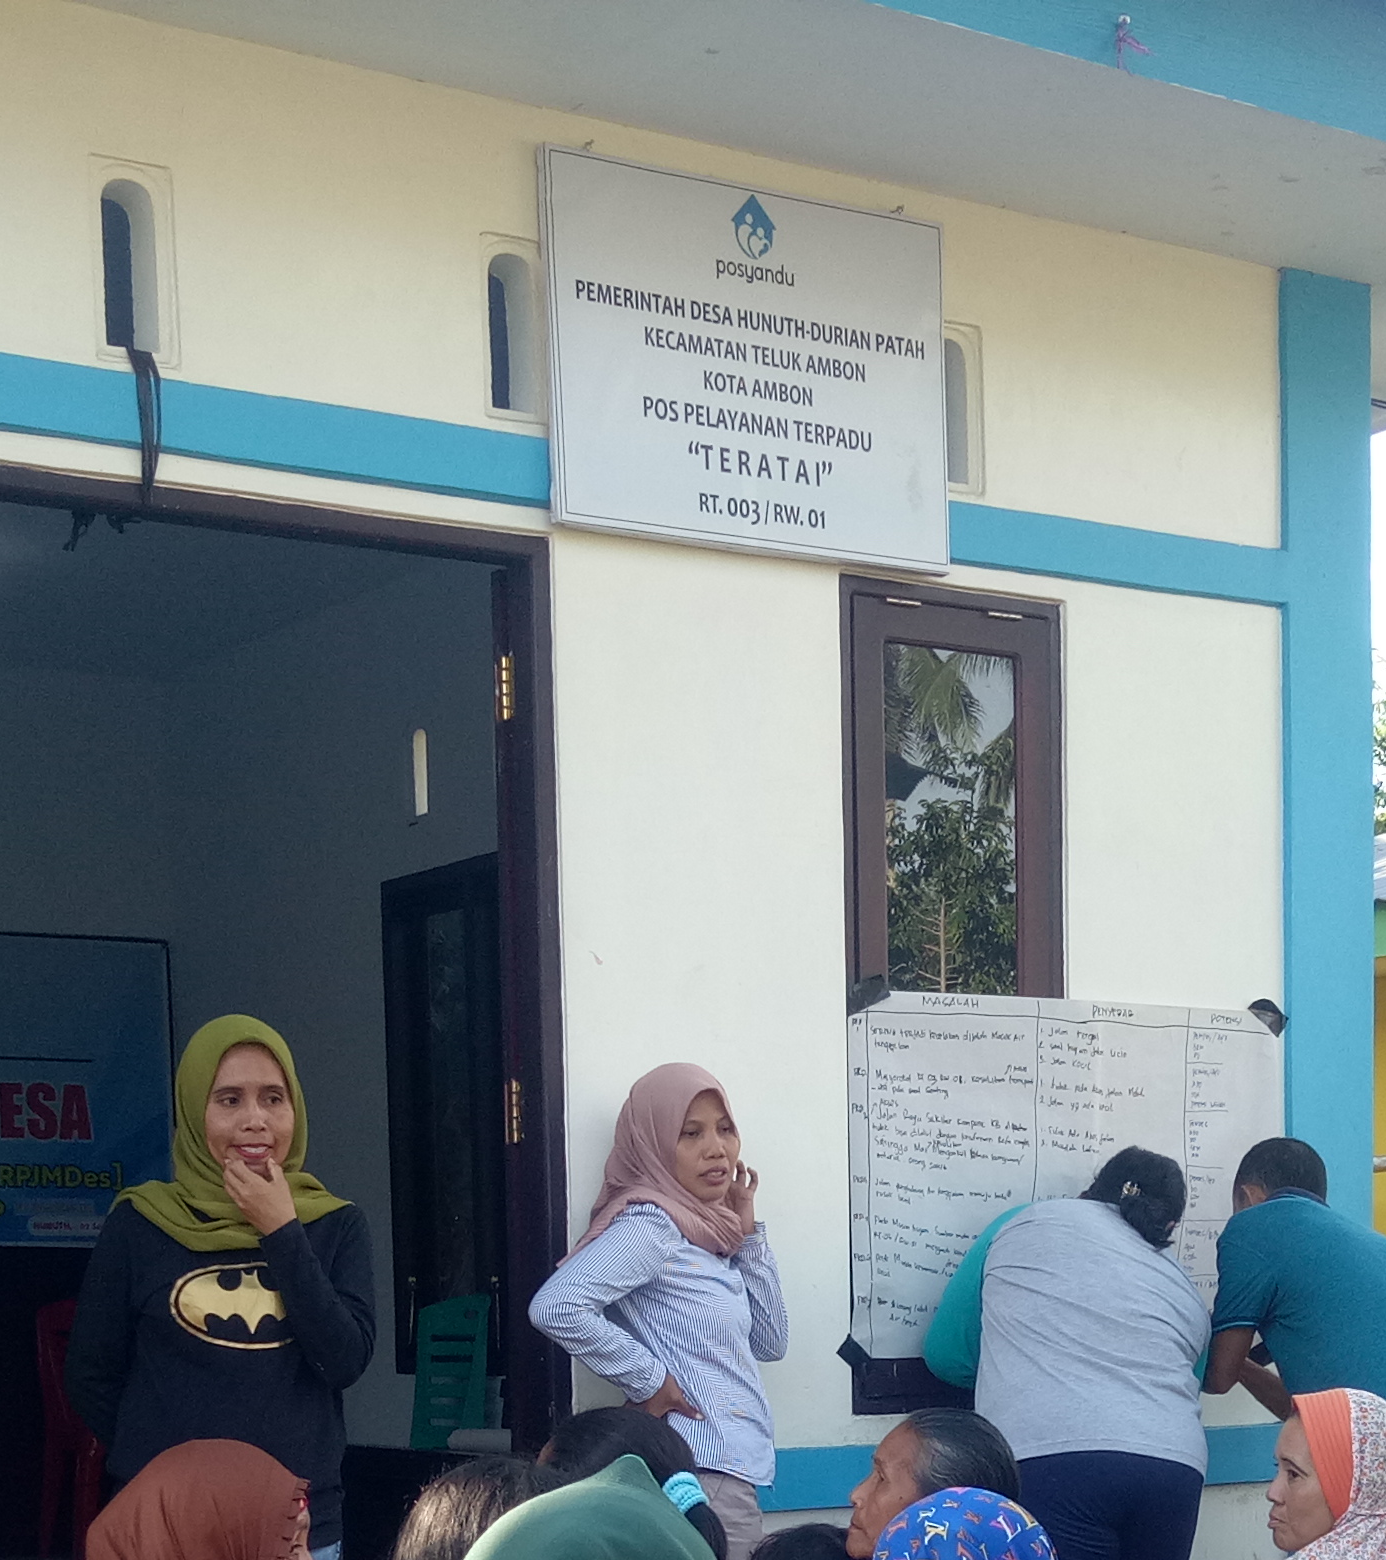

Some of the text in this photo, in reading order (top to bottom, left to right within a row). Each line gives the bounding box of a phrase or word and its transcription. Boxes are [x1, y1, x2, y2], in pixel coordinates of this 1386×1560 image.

[715, 258, 795, 288] posyandu
[575, 279, 925, 361] PEMERINTAH DESA HUNUTH-DURIAN PATAH
[644, 326, 867, 383] KECAMATAN TELUK AMBON
[703, 370, 813, 408] KOTA AMBON
[642, 395, 873, 453] POS PELAYANAN TERPADU
[699, 492, 723, 515] RT.
[727, 497, 761, 526] 003
[773, 505, 804, 528] RW.
[808, 509, 826, 530] 01
